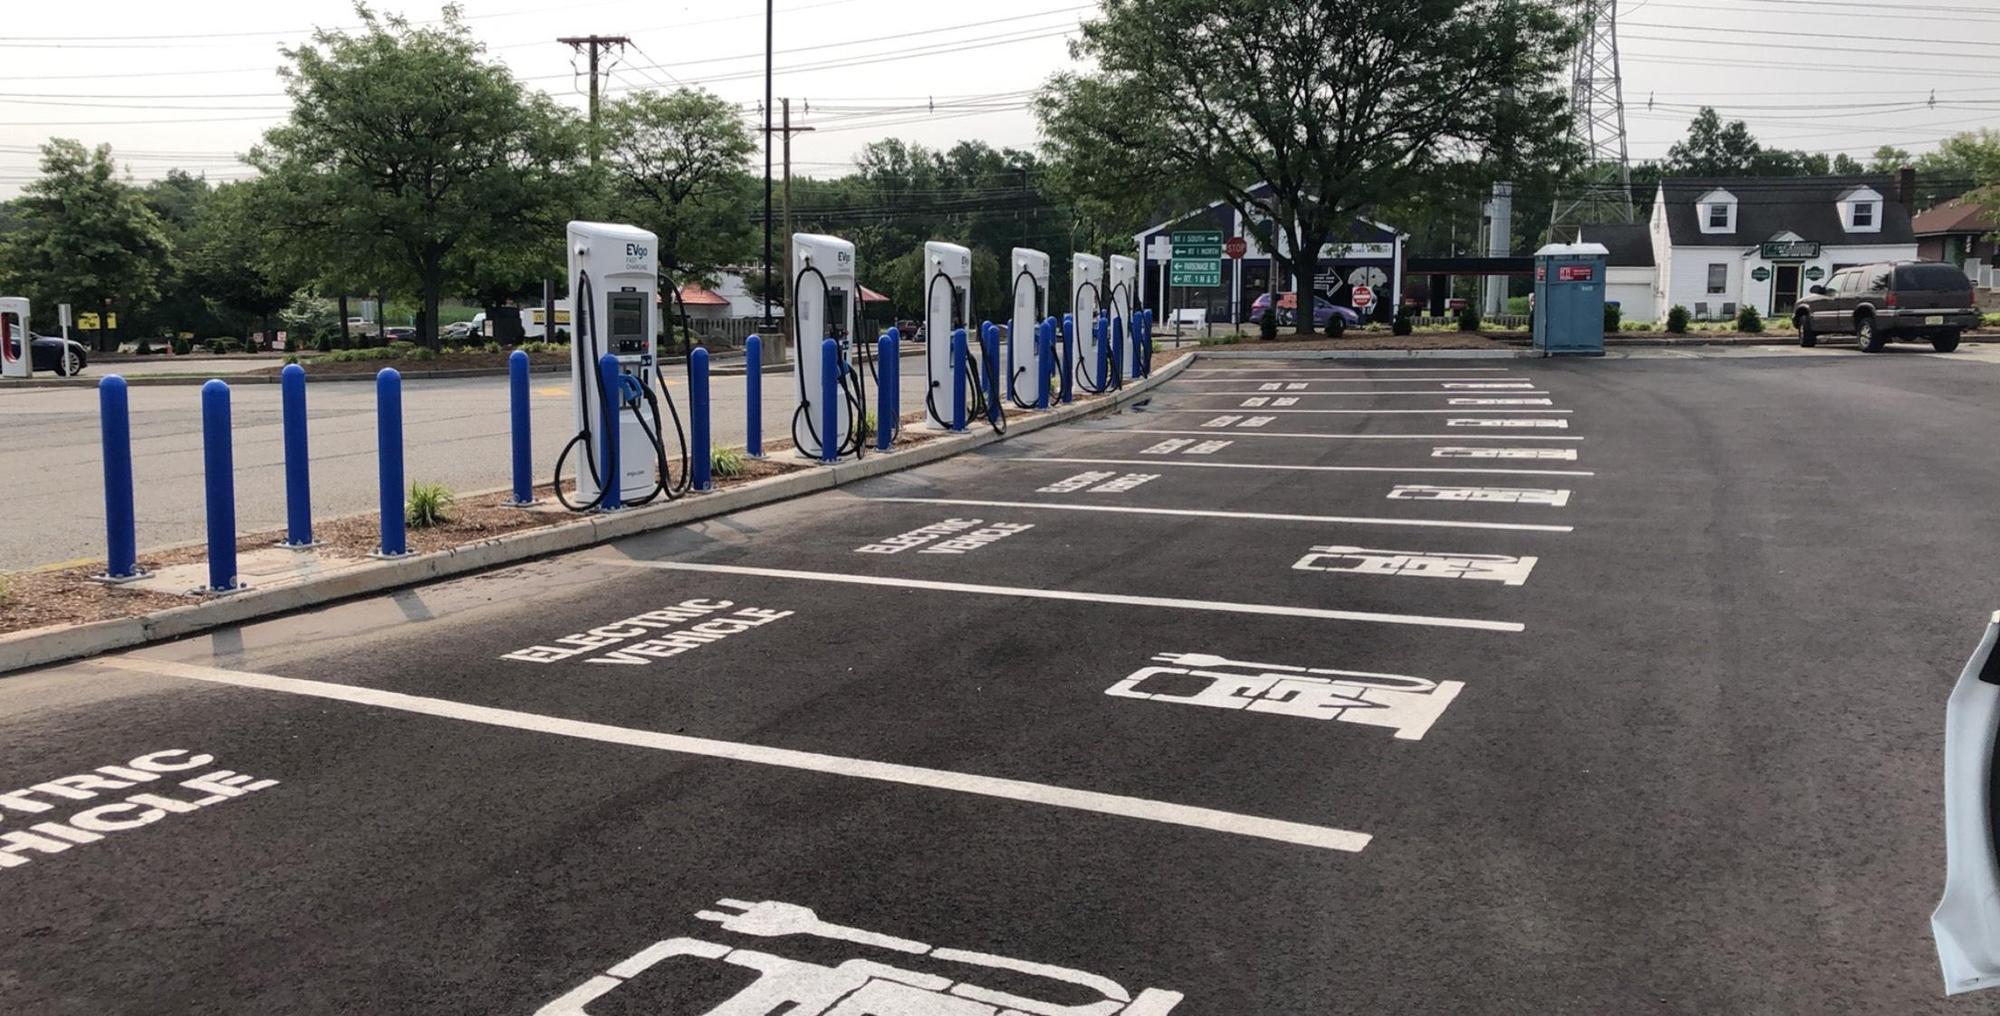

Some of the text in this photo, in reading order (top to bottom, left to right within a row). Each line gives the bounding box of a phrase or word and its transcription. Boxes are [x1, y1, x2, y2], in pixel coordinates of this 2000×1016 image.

[626, 243, 648, 260] EVgo
[1227, 244, 1246, 253] STOP
[853, 518, 984, 555] ELECTRIC
[917, 522, 1036, 555] VEHICLE
[499, 598, 734, 664] ELECTRIC
[583, 606, 795, 665] VEHICLE
[0, 749, 214, 823] TRIC
